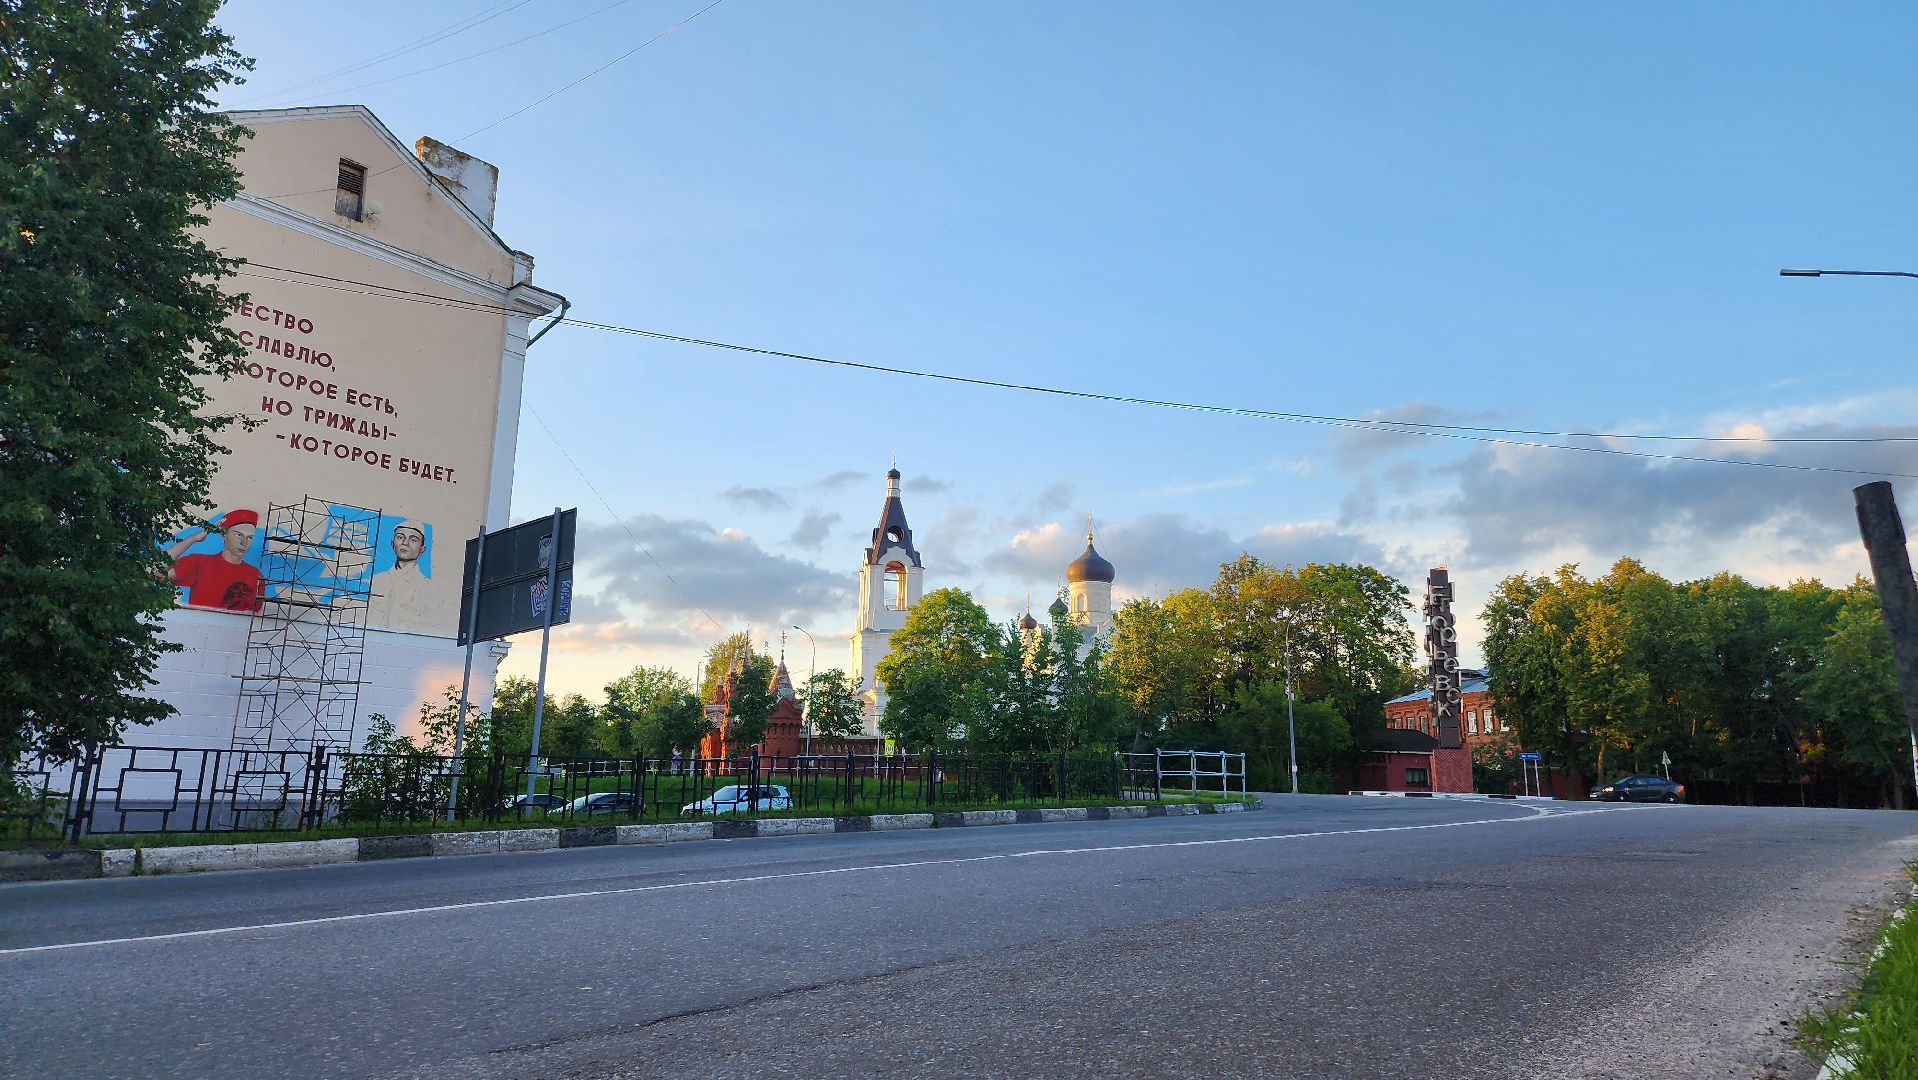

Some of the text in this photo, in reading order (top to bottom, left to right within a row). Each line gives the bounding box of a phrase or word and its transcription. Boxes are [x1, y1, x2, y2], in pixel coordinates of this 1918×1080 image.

[238, 330, 337, 373] СЛАВЛЮ,
[261, 396, 293, 417] НО
[346, 388, 399, 419] ЕСТЬ,
[399, 457, 457, 485] БУДЕТ.
